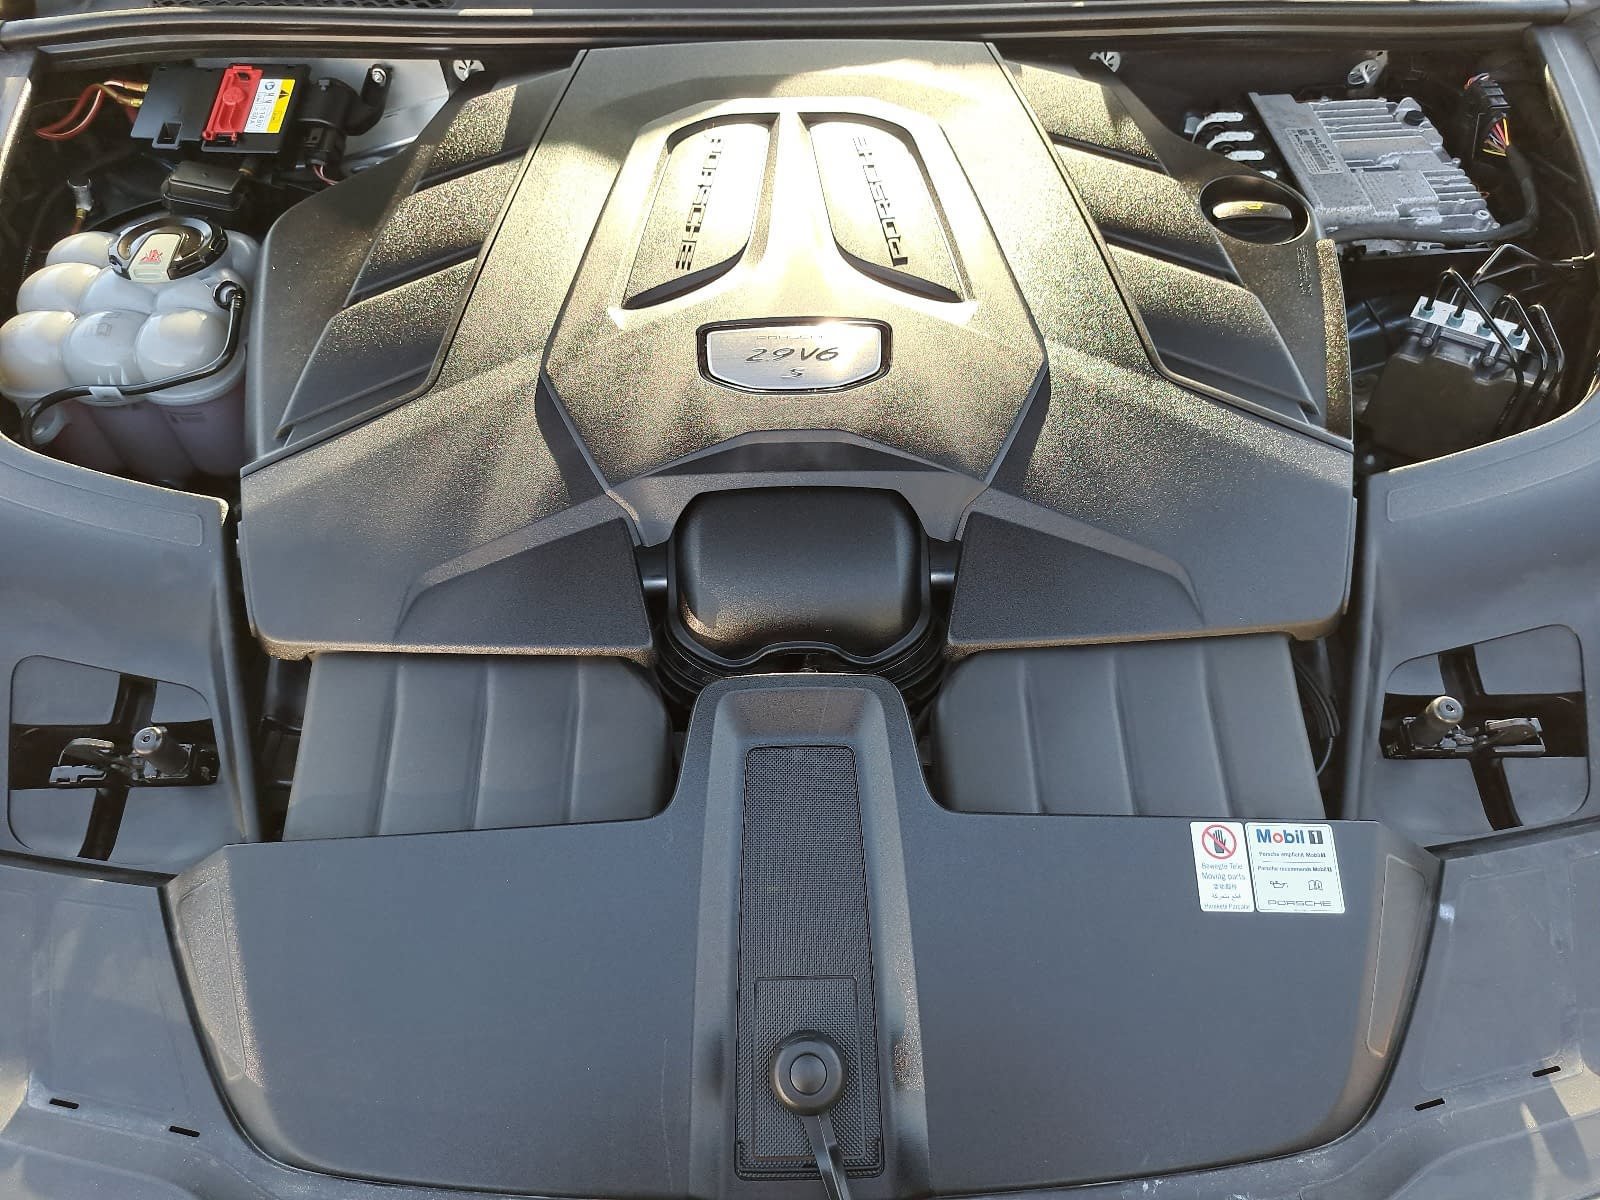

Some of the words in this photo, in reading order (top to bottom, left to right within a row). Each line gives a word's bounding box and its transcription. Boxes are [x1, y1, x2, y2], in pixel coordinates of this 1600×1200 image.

[675, 134, 722, 270] PORSCHE
[852, 136, 909, 267] PORSCHE
[1256, 828, 1305, 844] Mobil
[1201, 872, 1226, 881] Moving
[1227, 873, 1246, 881] parts
[1268, 899, 1332, 907] PORSCHE
